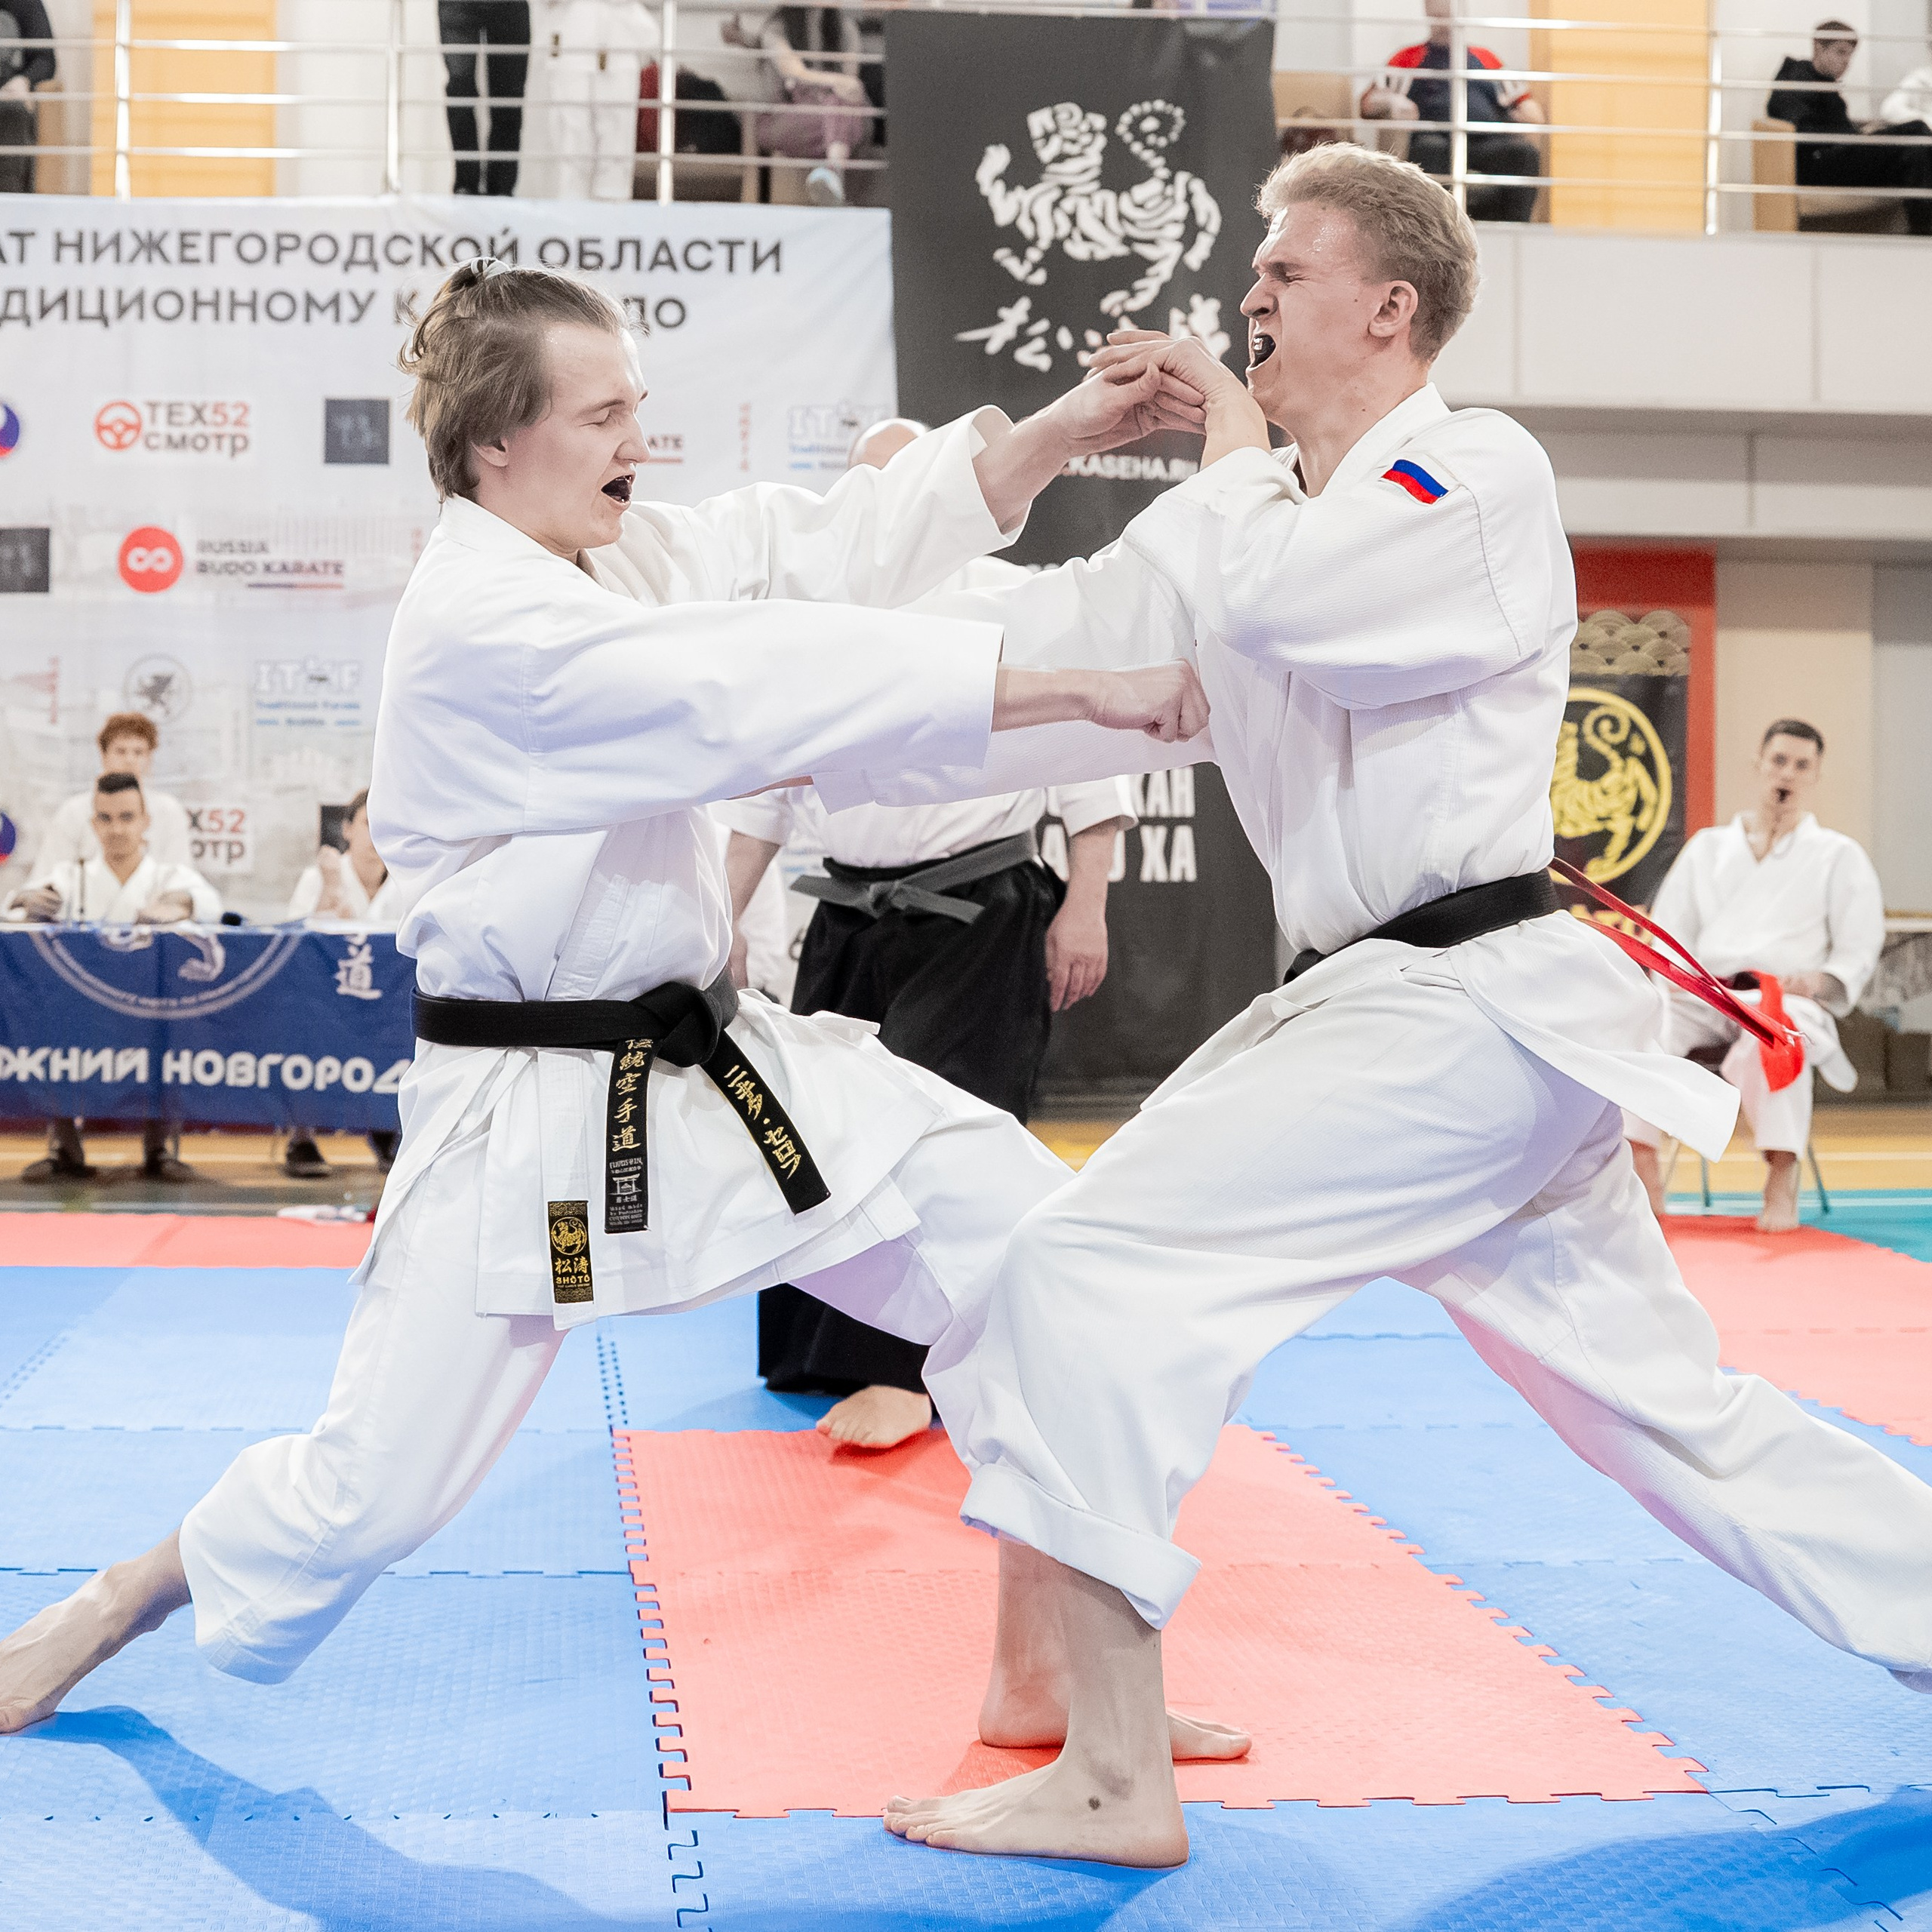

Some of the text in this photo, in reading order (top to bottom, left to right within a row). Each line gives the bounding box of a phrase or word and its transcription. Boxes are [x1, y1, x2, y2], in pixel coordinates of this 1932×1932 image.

[54, 228, 518, 272] НИЖЕГОРОДСКОЙ
[538, 238, 783, 274] ОБЛАСТИ
[0, 288, 376, 328] ДИЦИОННОМУ
[162, 1049, 411, 1094] НОВГОРОД
[555, 1274, 591, 1284] SHOTO
